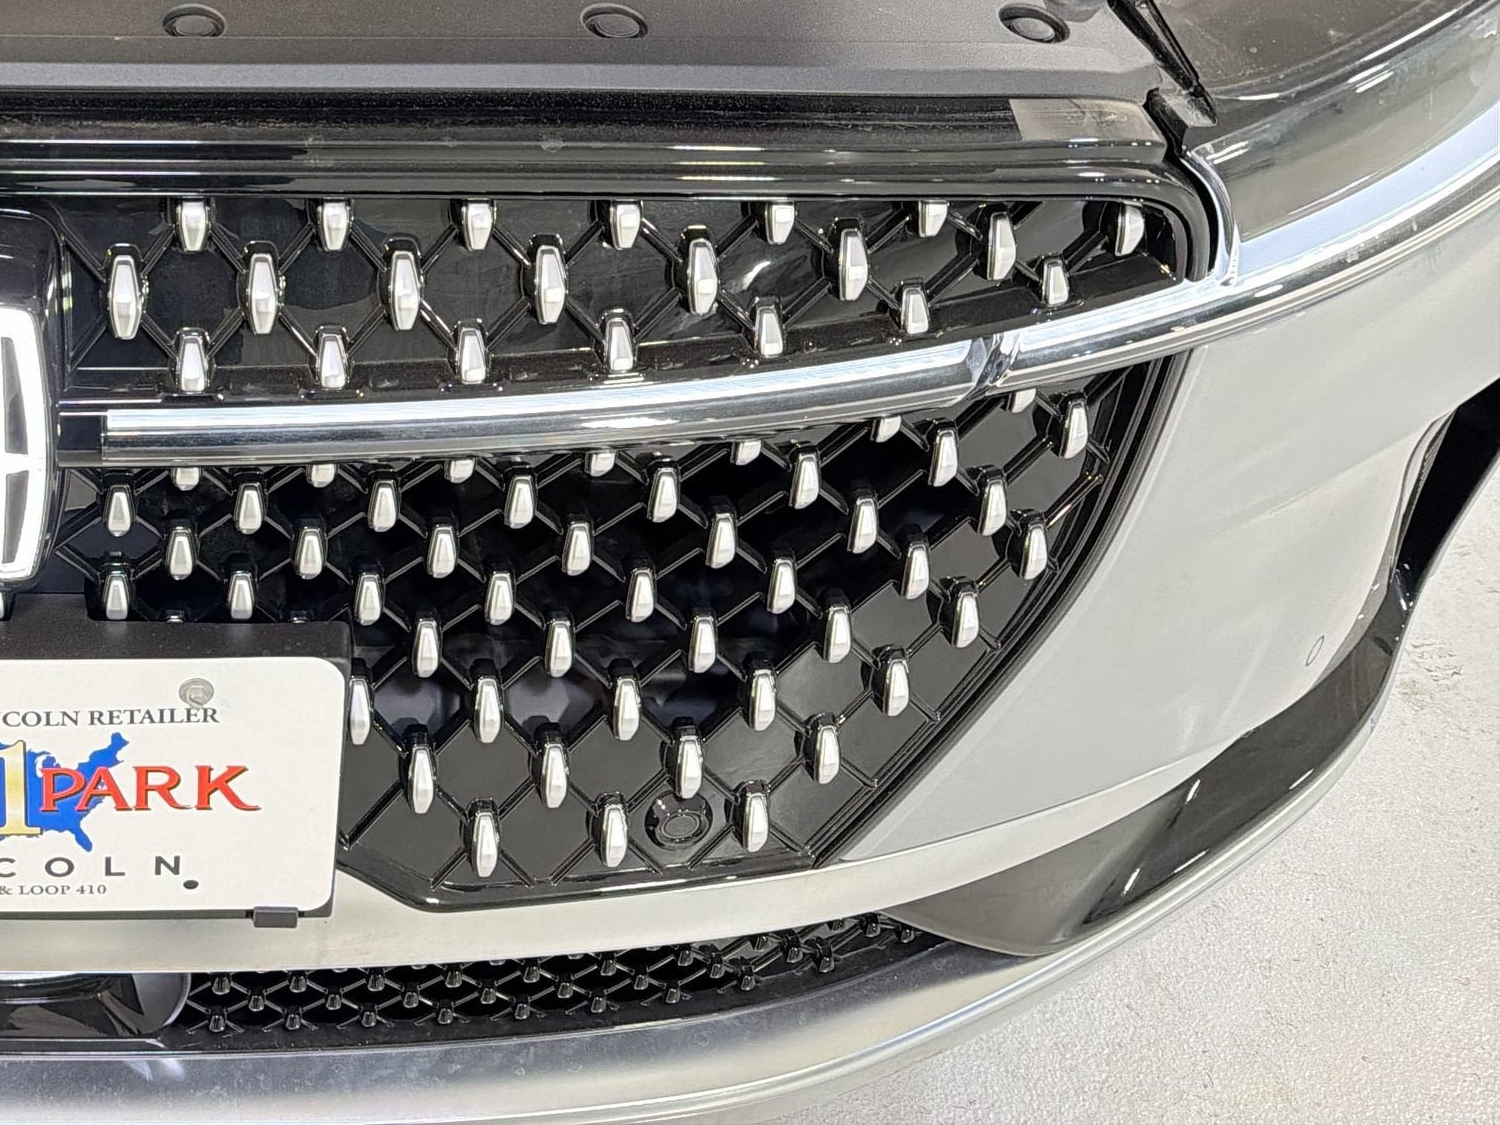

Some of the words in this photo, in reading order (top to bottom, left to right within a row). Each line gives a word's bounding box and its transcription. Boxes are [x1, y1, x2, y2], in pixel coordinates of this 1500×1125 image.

[88, 707, 220, 726] RETAILER
[39, 765, 262, 812] PARK
[18, 884, 71, 896] LOOP
[75, 884, 108, 895] 410
